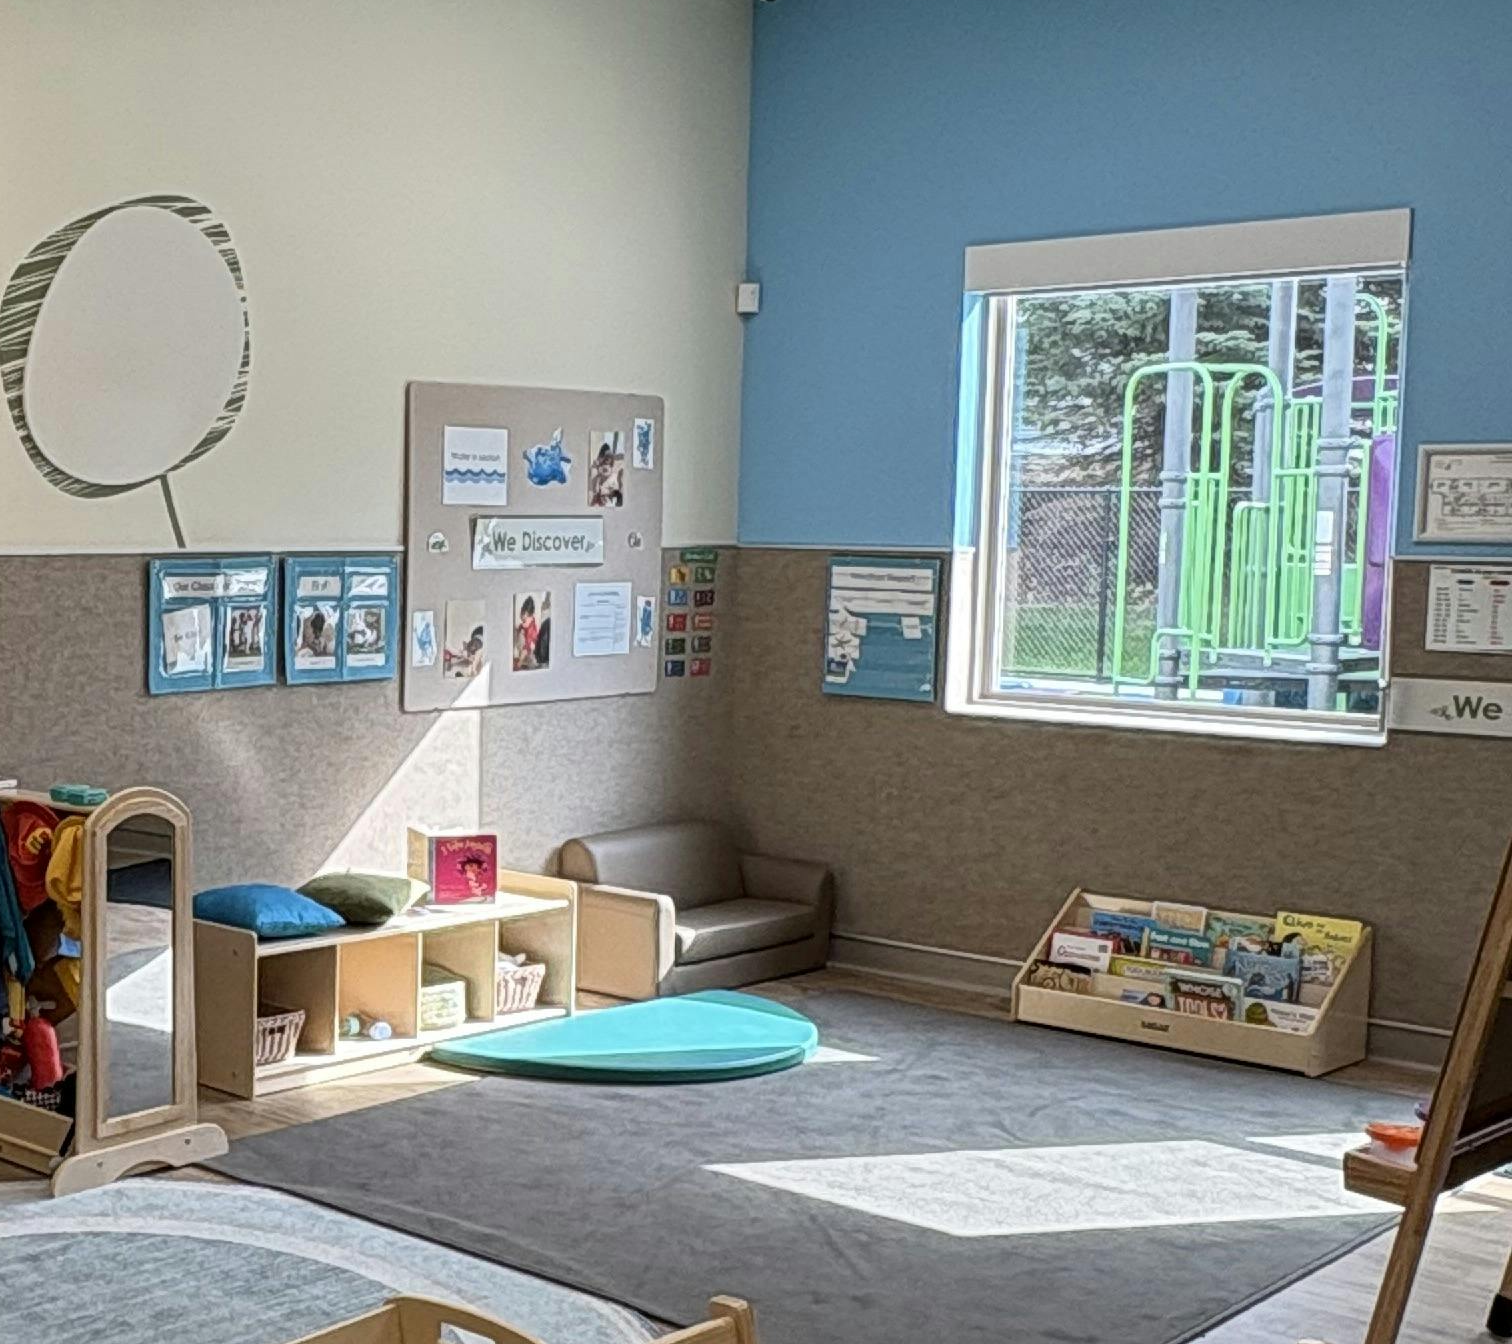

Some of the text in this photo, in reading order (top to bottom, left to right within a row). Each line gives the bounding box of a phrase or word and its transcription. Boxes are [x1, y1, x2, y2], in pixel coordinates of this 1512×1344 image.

[492, 530, 586, 552] We Discover
[1453, 695, 1503, 721] We
